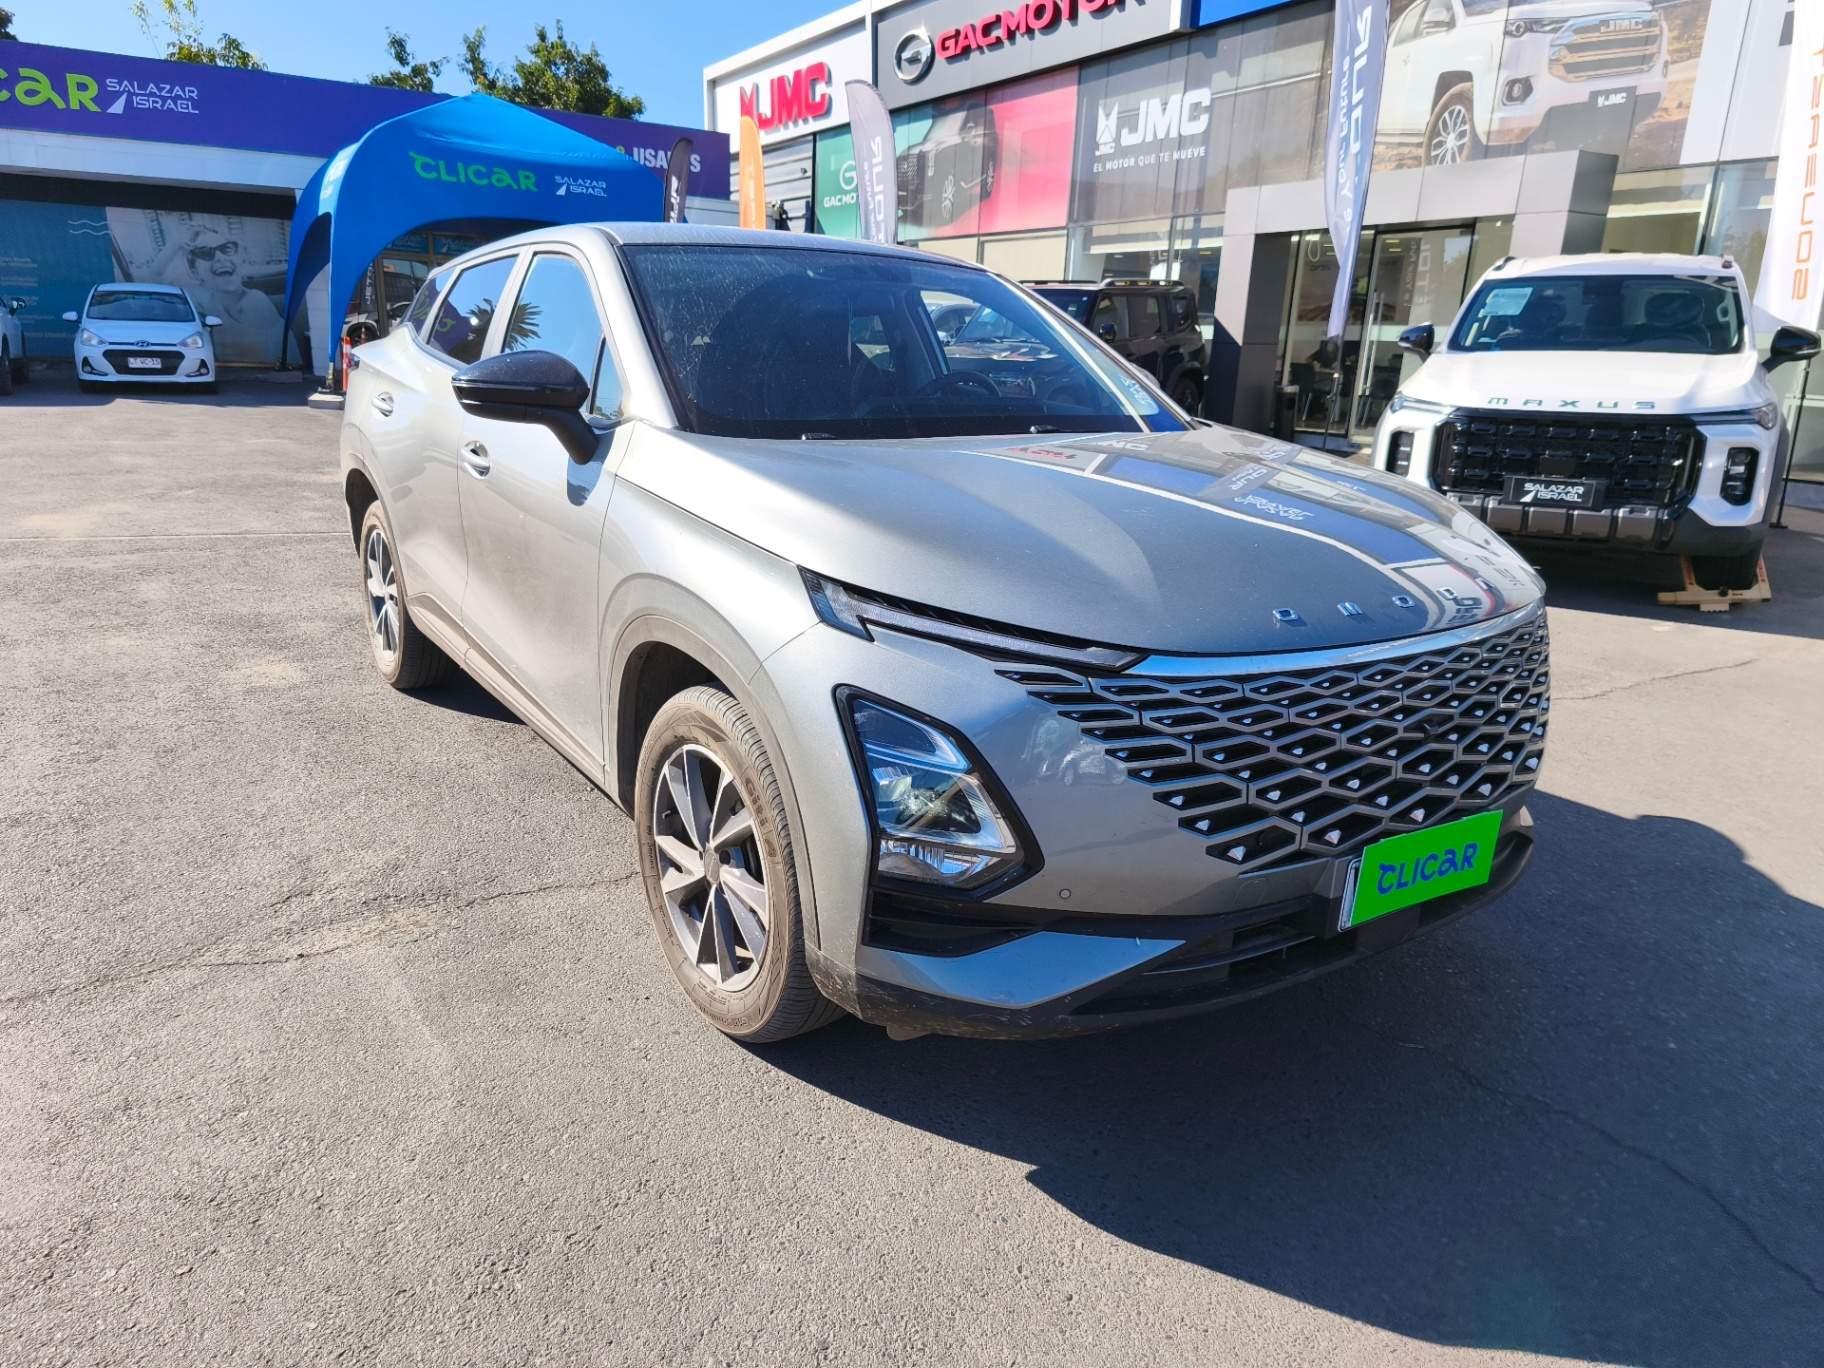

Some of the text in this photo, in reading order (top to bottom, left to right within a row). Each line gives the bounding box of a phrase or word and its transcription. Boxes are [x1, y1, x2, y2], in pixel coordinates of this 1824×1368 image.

[105, 78, 199, 100] SALAZAR
[757, 62, 832, 131] JMC
[133, 95, 200, 114] ISRAEL
[1120, 87, 1212, 146] JMC
[1106, 157, 1135, 170] MOTOR
[1138, 154, 1156, 166] QUE
[1159, 152, 1169, 162] TE
[1173, 146, 1206, 161] MUEVE
[554, 175, 607, 188] SALAZAR
[569, 184, 608, 197] ISRAEL
[1487, 396, 1656, 410] MAXUS
[1523, 482, 1585, 495] SALAZAR
[1537, 491, 1583, 502] ISRAEL
